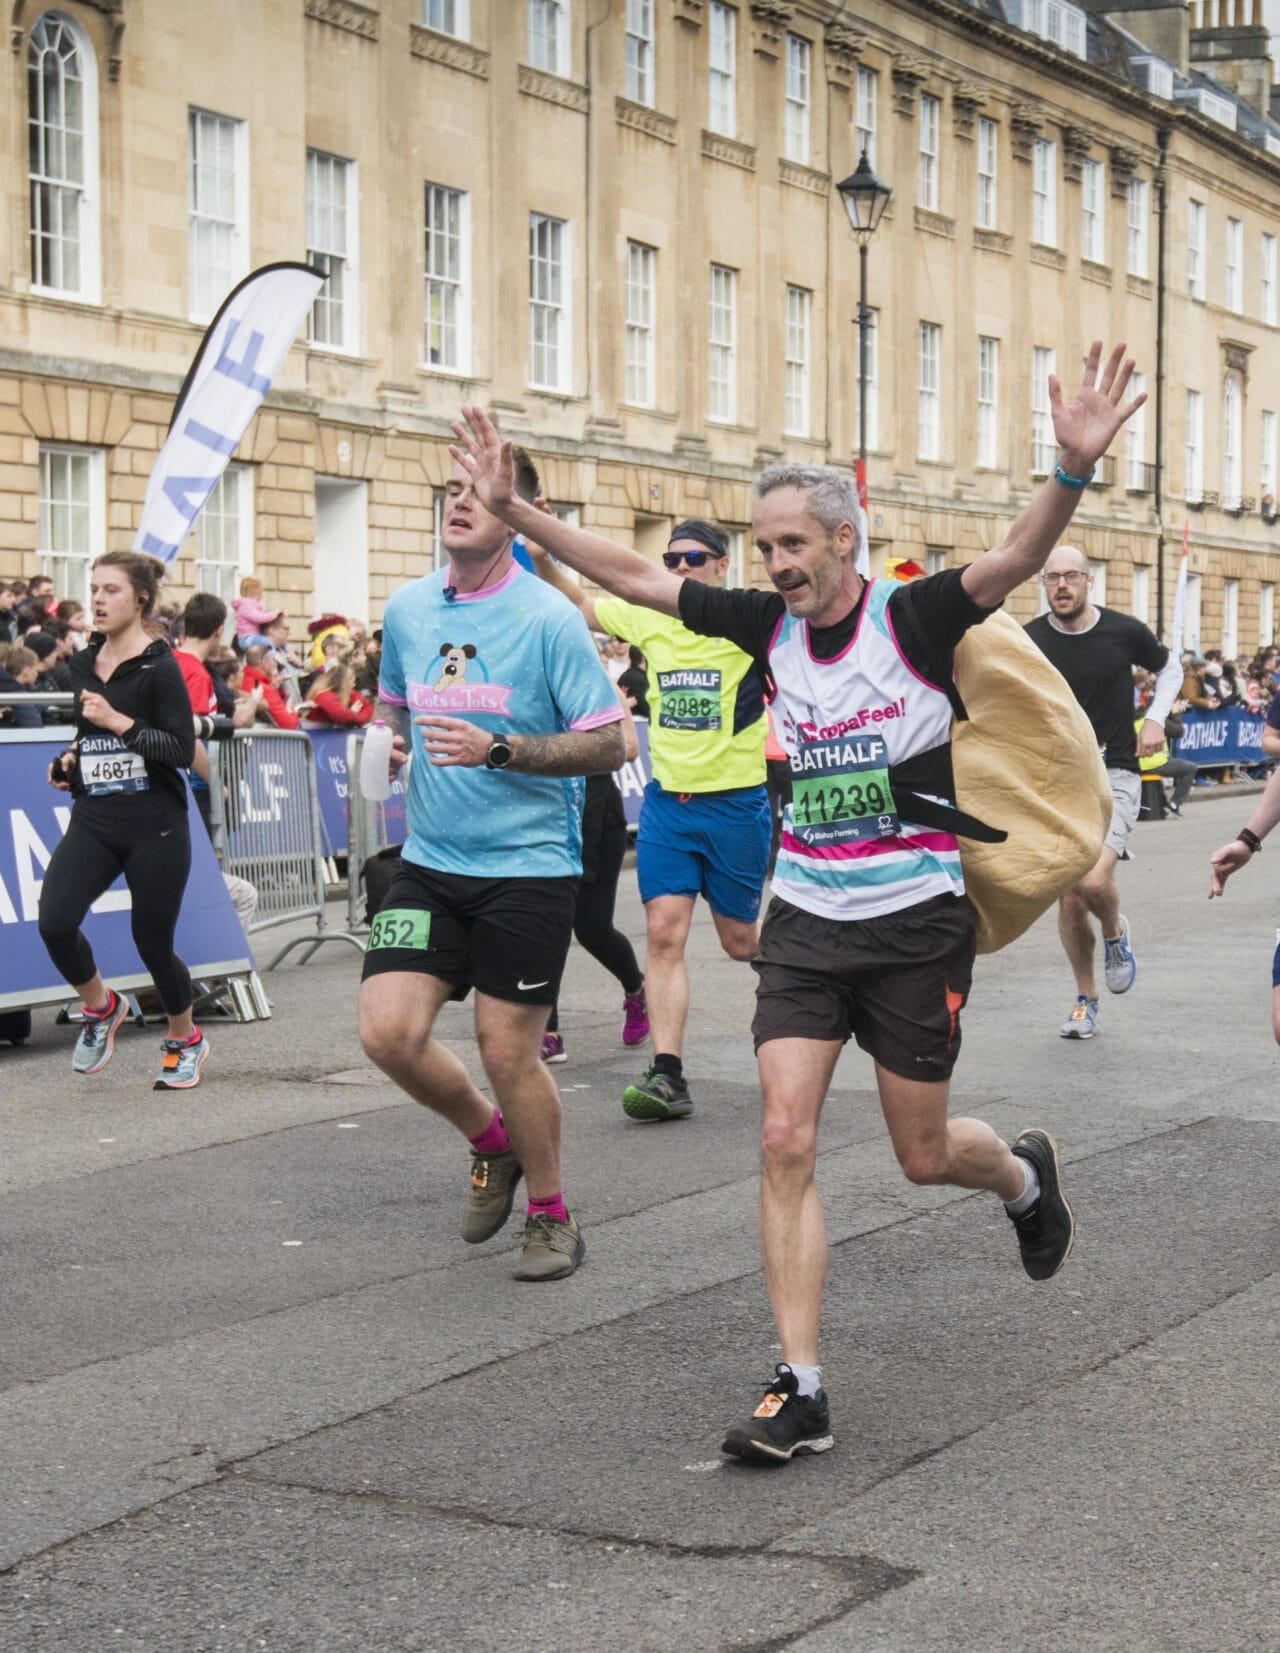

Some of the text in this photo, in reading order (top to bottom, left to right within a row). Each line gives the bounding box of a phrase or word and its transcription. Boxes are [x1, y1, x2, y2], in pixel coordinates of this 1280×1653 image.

[660, 672, 720, 687] BATHALF
[413, 688, 449, 708] Cots
[461, 688, 498, 709] Tots
[328, 755, 347, 774] It's
[790, 741, 884, 773] BATHALF
[800, 782, 885, 823] 11239
[814, 828, 859, 840] Bishop Fleming
